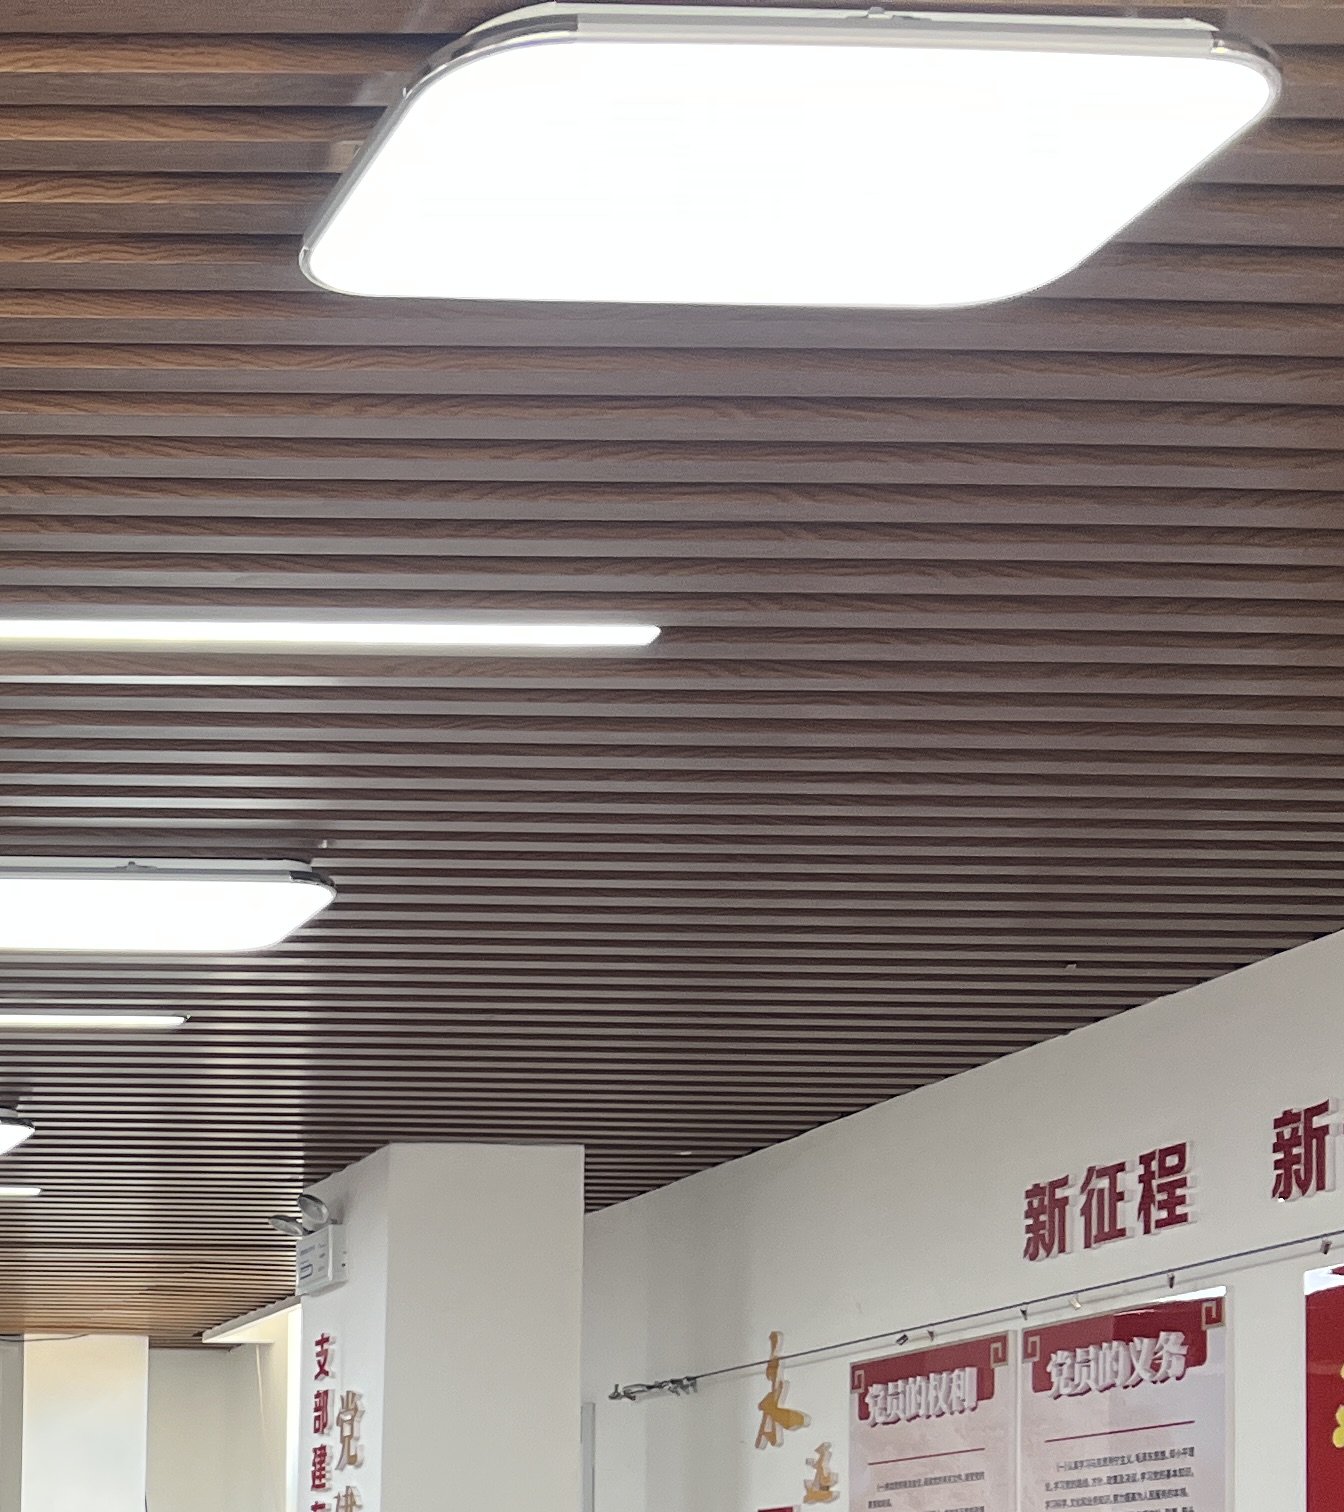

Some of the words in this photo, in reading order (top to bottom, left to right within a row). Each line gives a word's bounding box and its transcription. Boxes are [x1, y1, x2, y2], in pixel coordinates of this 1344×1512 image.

[1271, 1099, 1344, 1200] 新
[1023, 1141, 1188, 1260] 新征程
[865, 1367, 977, 1426] 党员的权利
[1047, 1331, 1188, 1399] 党员的义务
